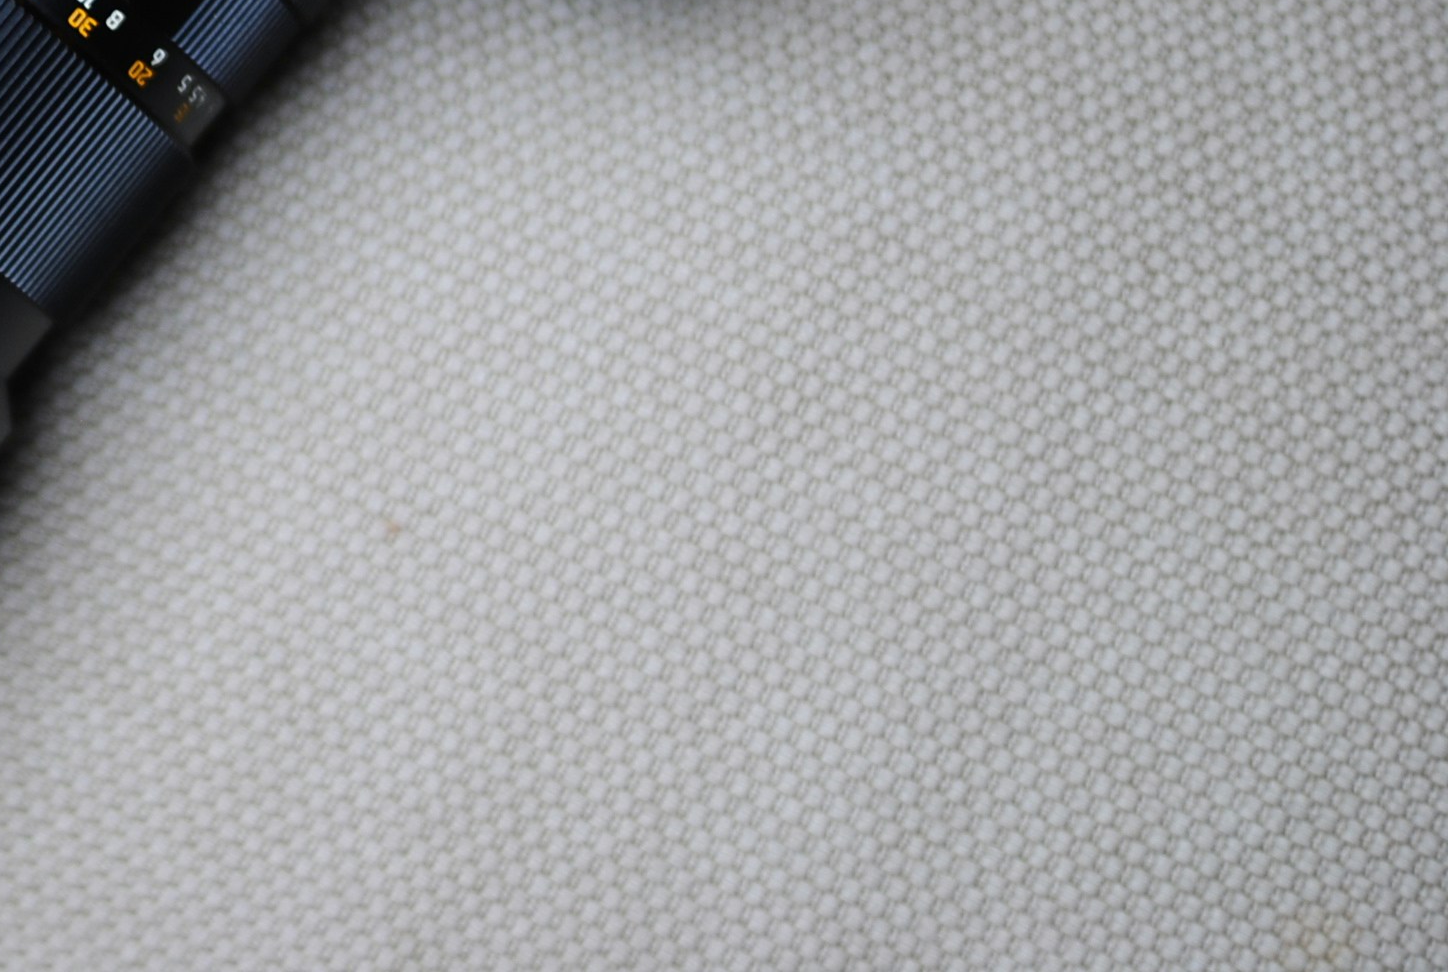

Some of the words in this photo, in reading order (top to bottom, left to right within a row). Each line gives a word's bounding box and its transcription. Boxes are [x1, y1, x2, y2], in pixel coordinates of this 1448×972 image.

[68, 7, 98, 38] 30
[105, 9, 125, 31] 8
[151, 48, 167, 66] 6
[128, 60, 153, 87] 20
